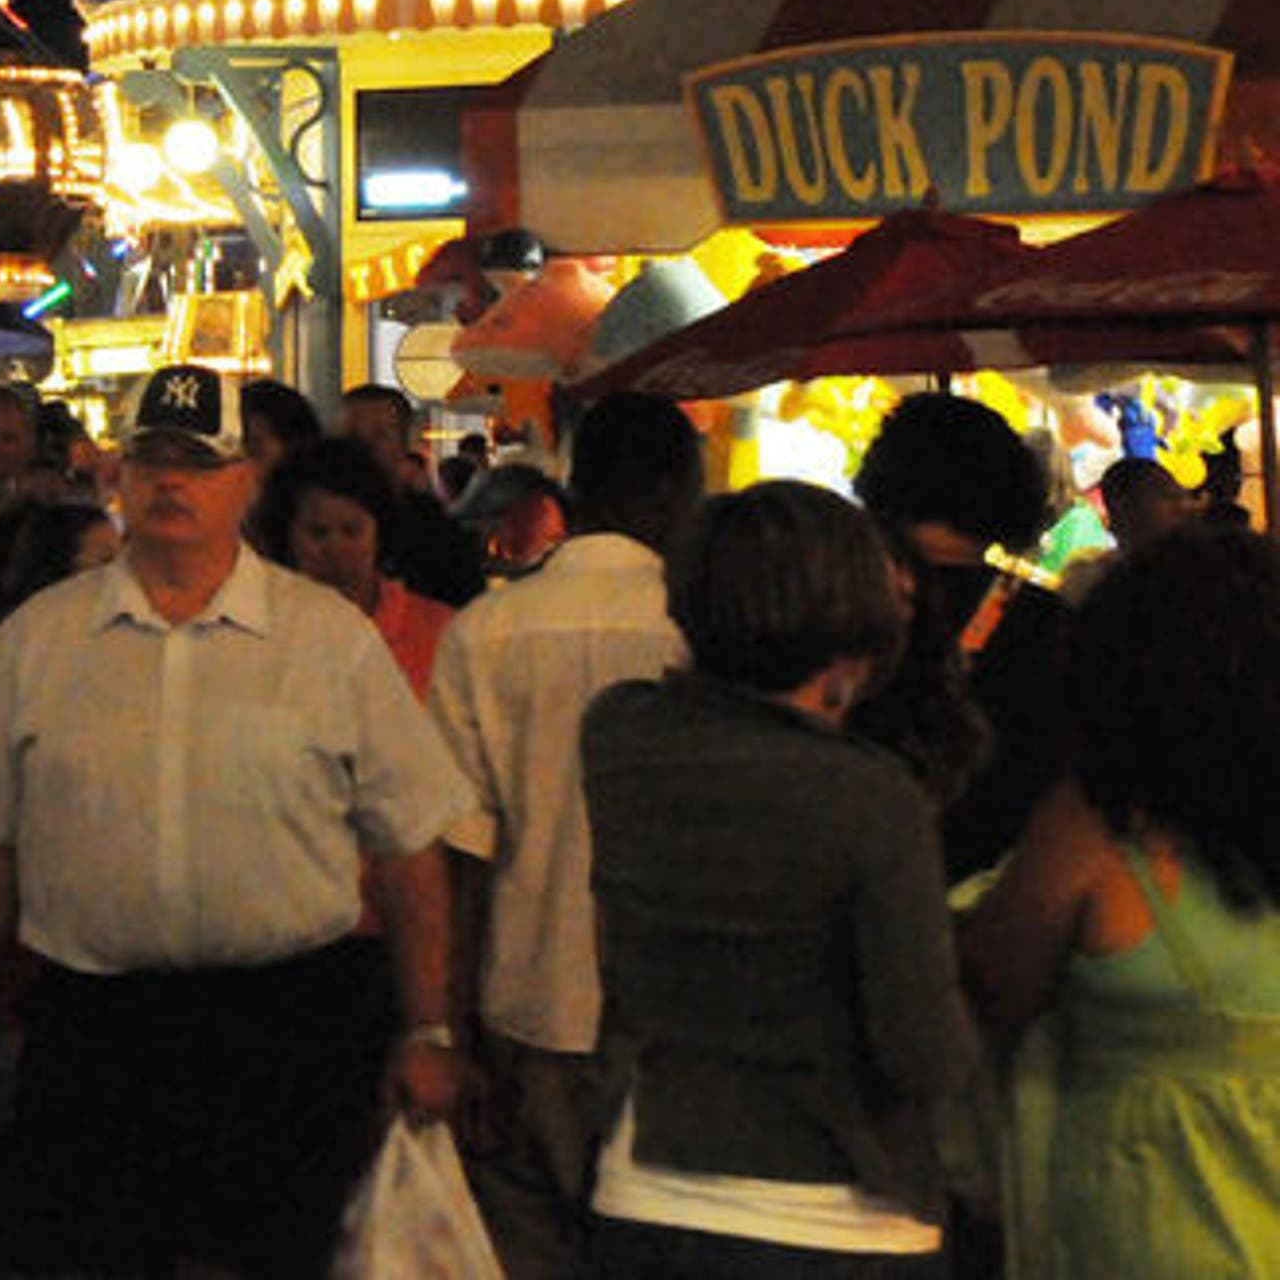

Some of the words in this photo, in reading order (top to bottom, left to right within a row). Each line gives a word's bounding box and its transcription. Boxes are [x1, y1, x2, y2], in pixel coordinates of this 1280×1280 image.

[710, 62, 928, 204] DUCK
[961, 57, 1191, 197] POND
[160, 375, 201, 409] NY
